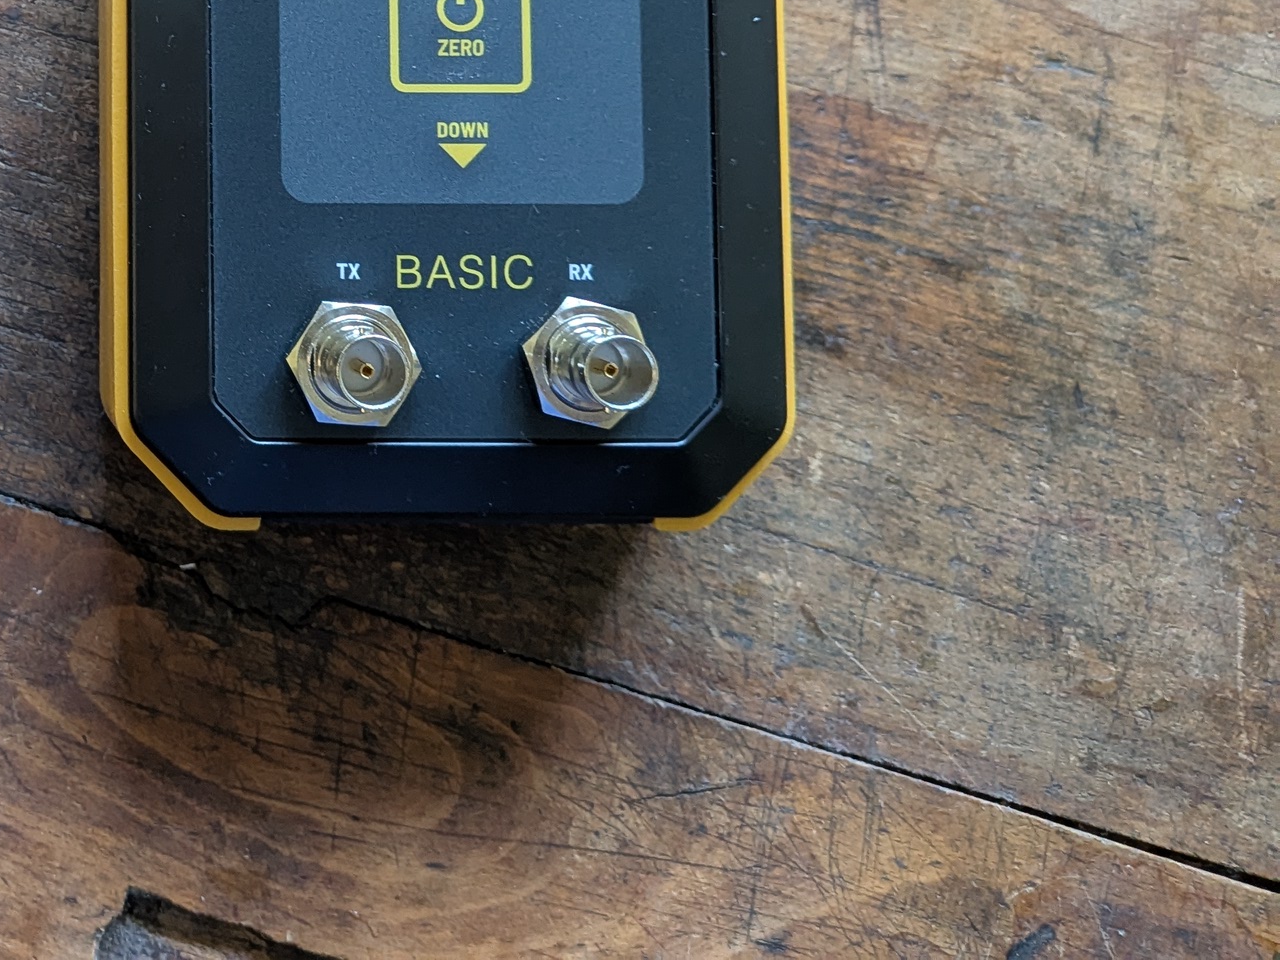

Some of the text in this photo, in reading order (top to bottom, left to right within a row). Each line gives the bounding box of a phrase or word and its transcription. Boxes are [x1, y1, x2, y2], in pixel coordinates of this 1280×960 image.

[437, 38, 485, 57] ZERO
[437, 122, 489, 139] DOWN
[336, 262, 361, 280] TX
[396, 254, 534, 290] BASIC
[568, 263, 594, 280] RX
